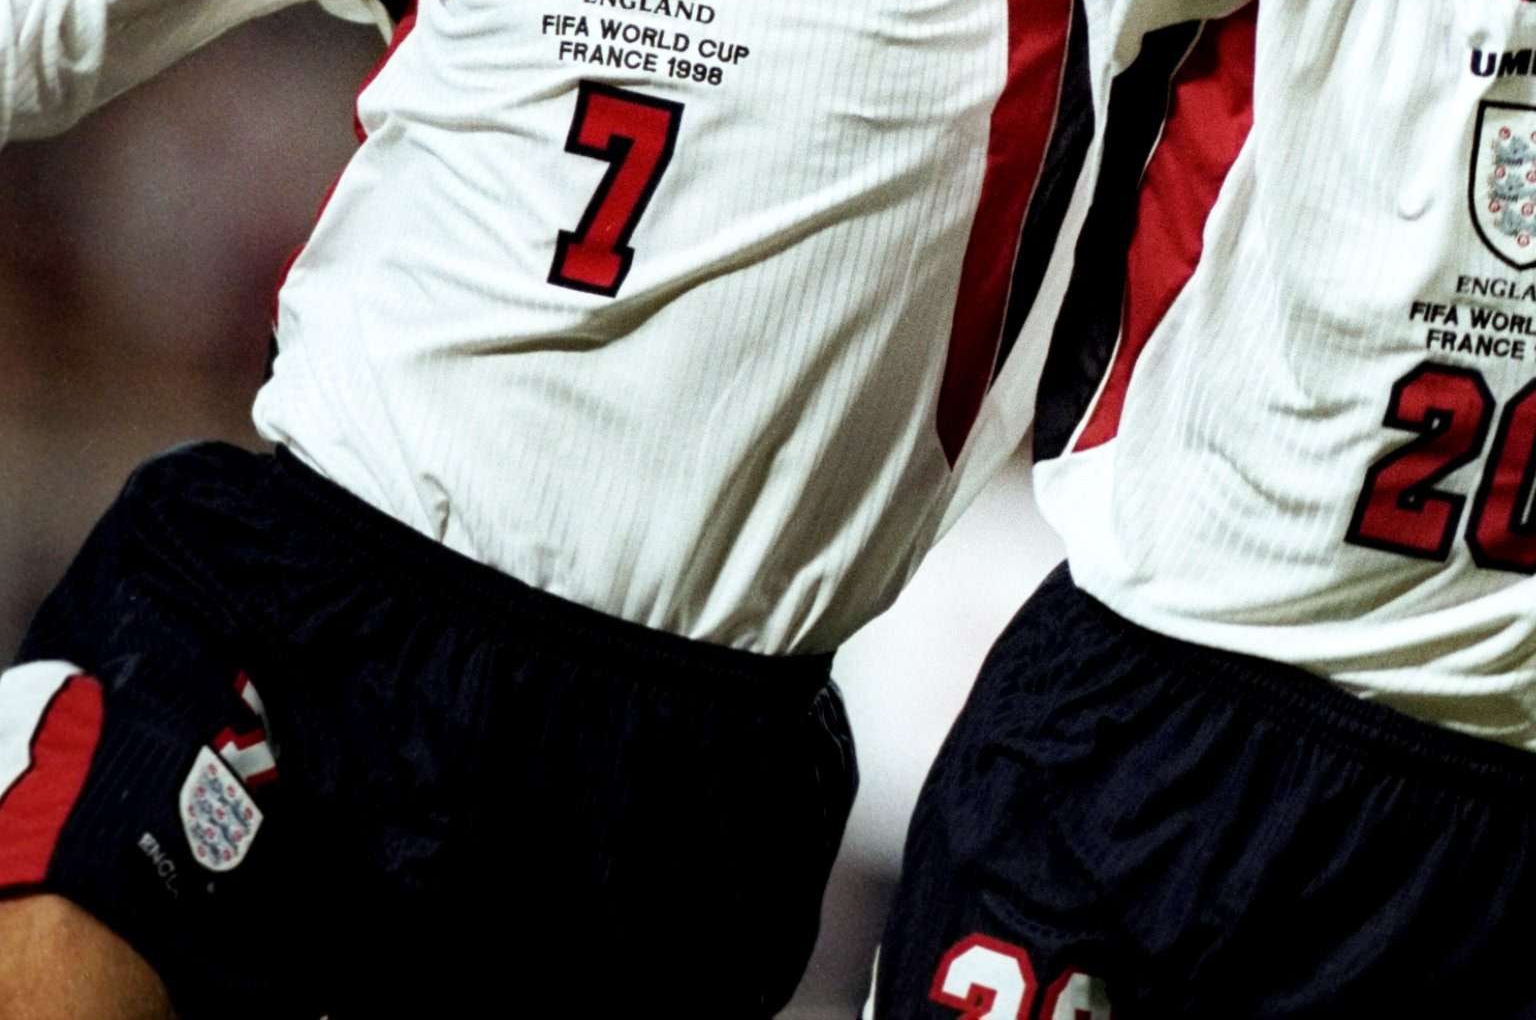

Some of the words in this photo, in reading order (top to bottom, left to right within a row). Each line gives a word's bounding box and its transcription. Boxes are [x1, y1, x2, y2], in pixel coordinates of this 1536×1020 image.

[542, 14, 589, 38] FIFA
[601, 18, 690, 53] WORLD
[698, 39, 750, 67] CUP
[558, 40, 657, 73] FRANCE
[667, 56, 723, 86] 1998
[547, 79, 685, 298] 7
[1409, 301, 1460, 329] FIFA
[1426, 329, 1525, 362] FRANCE
